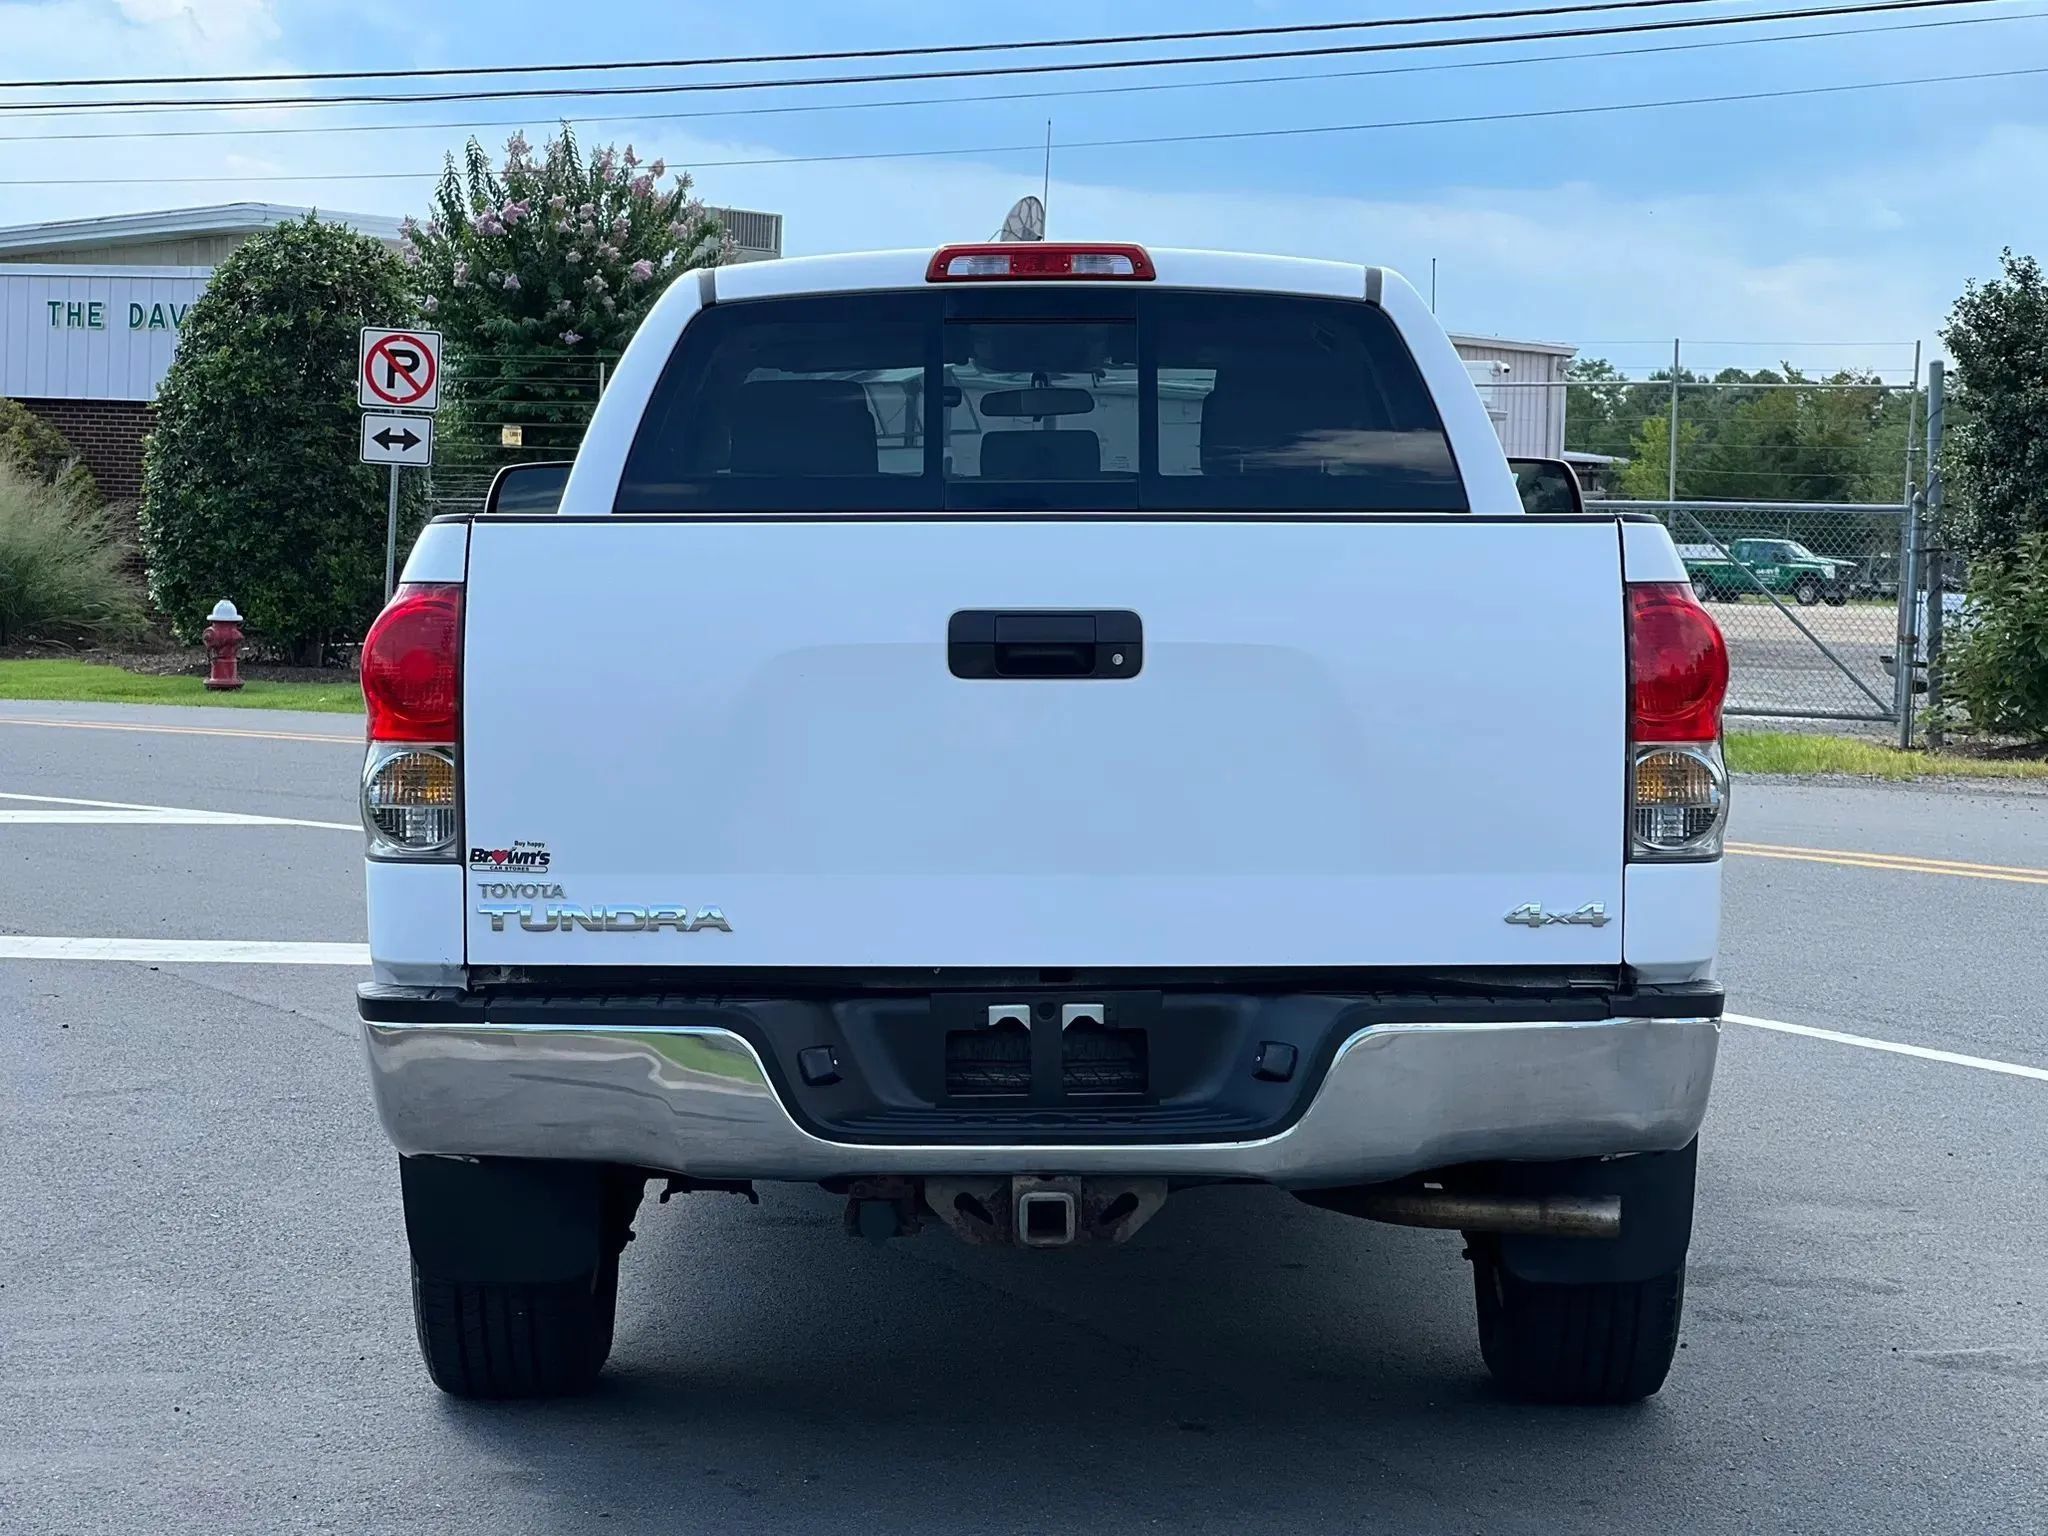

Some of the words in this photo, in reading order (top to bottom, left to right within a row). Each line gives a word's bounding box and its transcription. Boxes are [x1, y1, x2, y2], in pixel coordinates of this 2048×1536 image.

[47, 301, 103, 328] THE
[386, 348, 420, 389] P
[514, 840, 526, 848] Buy
[527, 841, 545, 849] happy
[477, 881, 567, 900] TOYOTA
[477, 903, 733, 932] TUNDRA
[1504, 900, 1612, 928] 4x4
